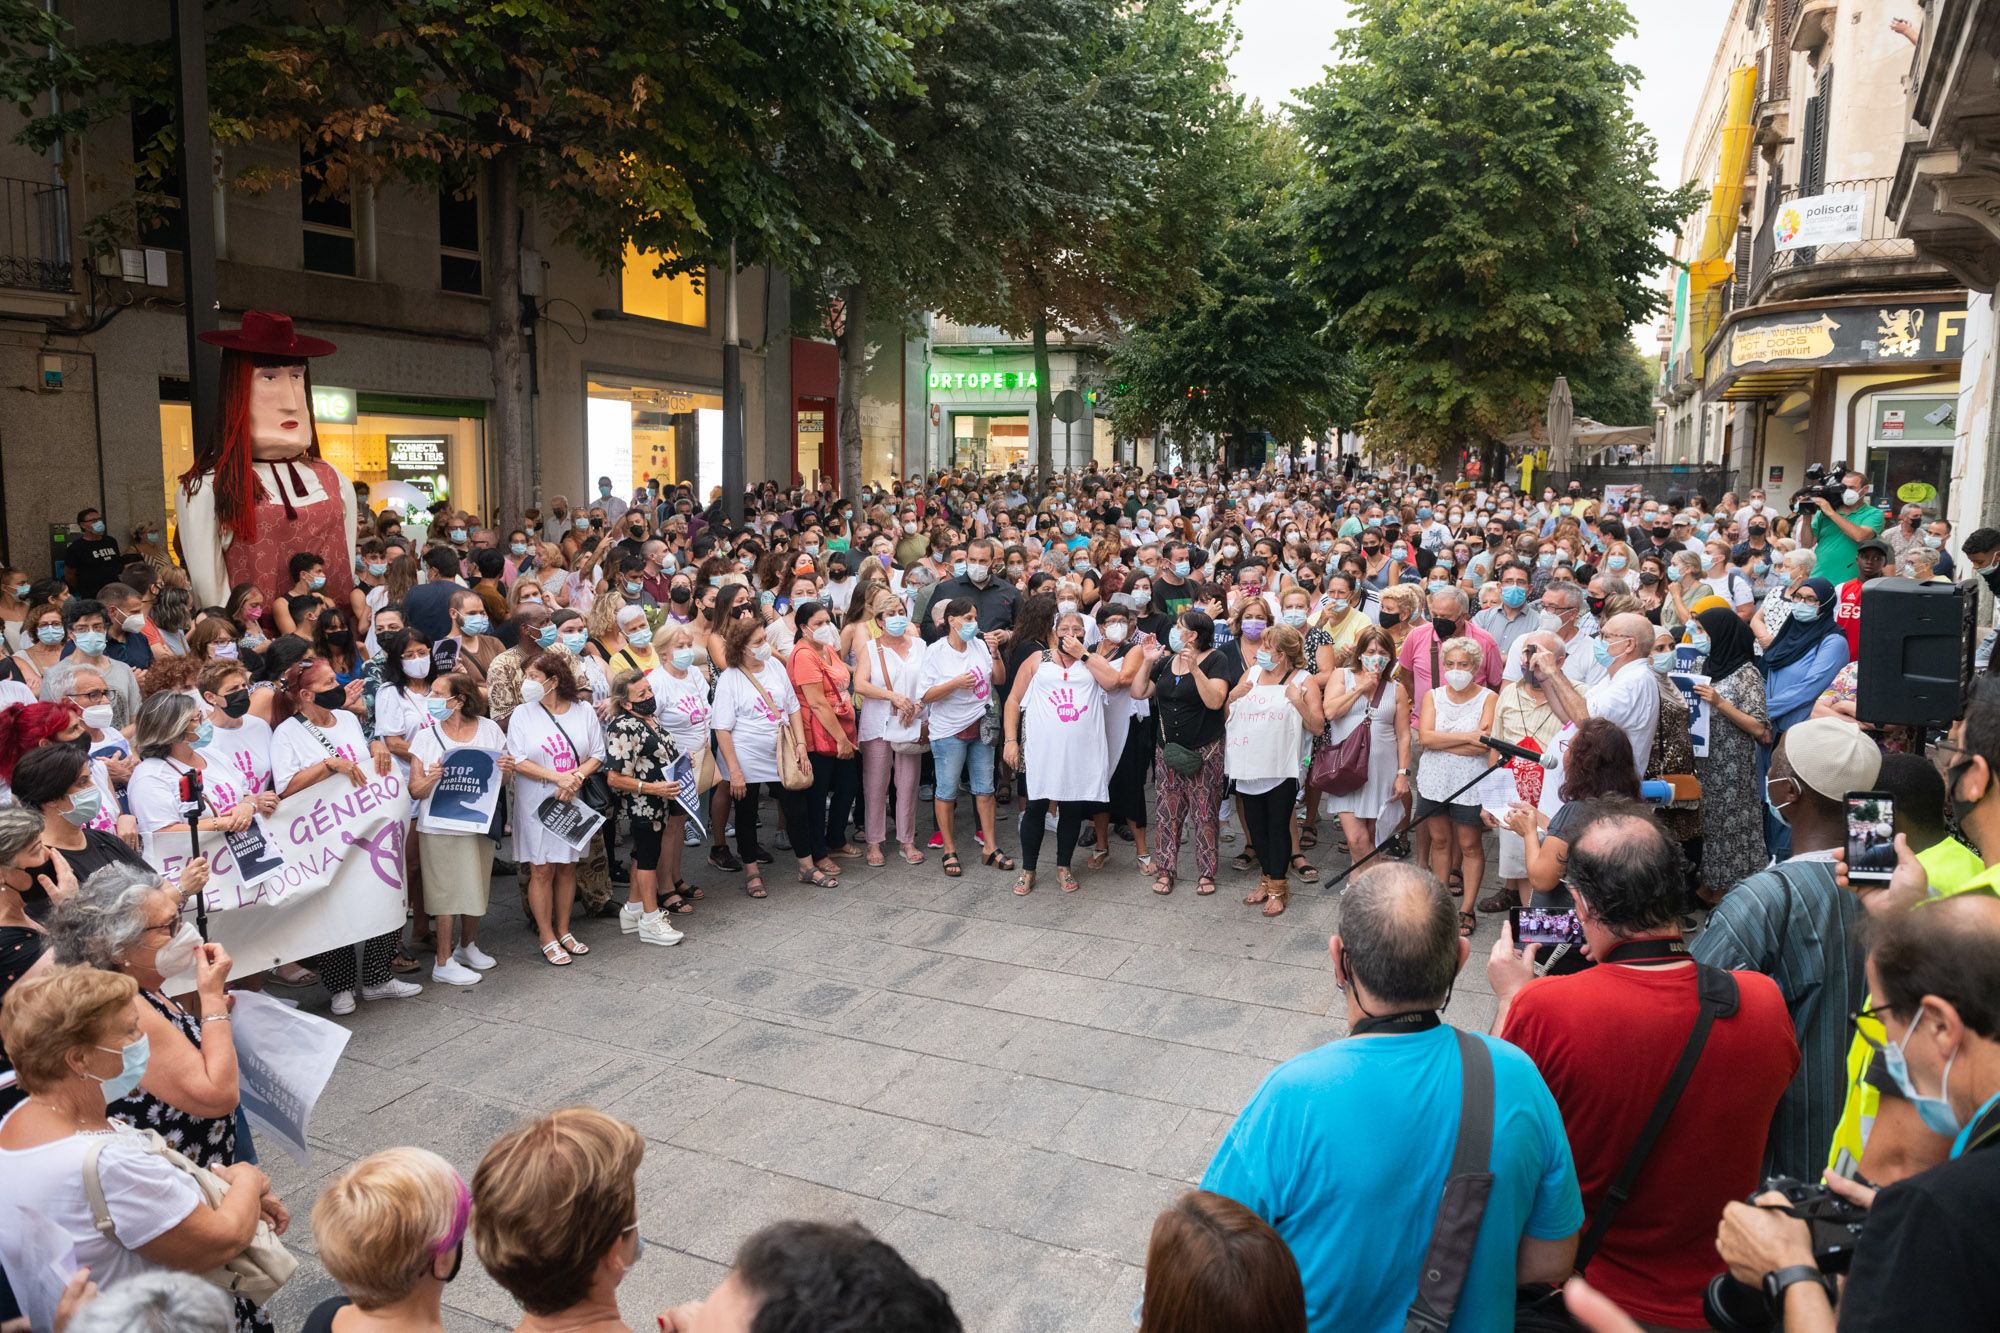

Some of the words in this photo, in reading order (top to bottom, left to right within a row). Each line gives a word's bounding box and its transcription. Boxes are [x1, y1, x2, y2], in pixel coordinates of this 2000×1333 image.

[1806, 204, 1858, 218] poliscau
[1936, 311, 1968, 352] F
[1741, 342, 1760, 352] HOT
[1767, 336, 1807, 347] DOGS
[929, 372, 1038, 390] ORTOPEDIA
[313, 393, 351, 418] ne
[397, 443, 438, 453] CONNECTA
[409, 452, 423, 461] ELS
[424, 452, 444, 461] TEUS
[1213, 633, 1235, 643] ENIM
[443, 766, 474, 777] STOP
[439, 784, 481, 794] MASCLISTA
[289, 775, 400, 845] GÉNERO
[543, 803, 566, 826] VOLEM
